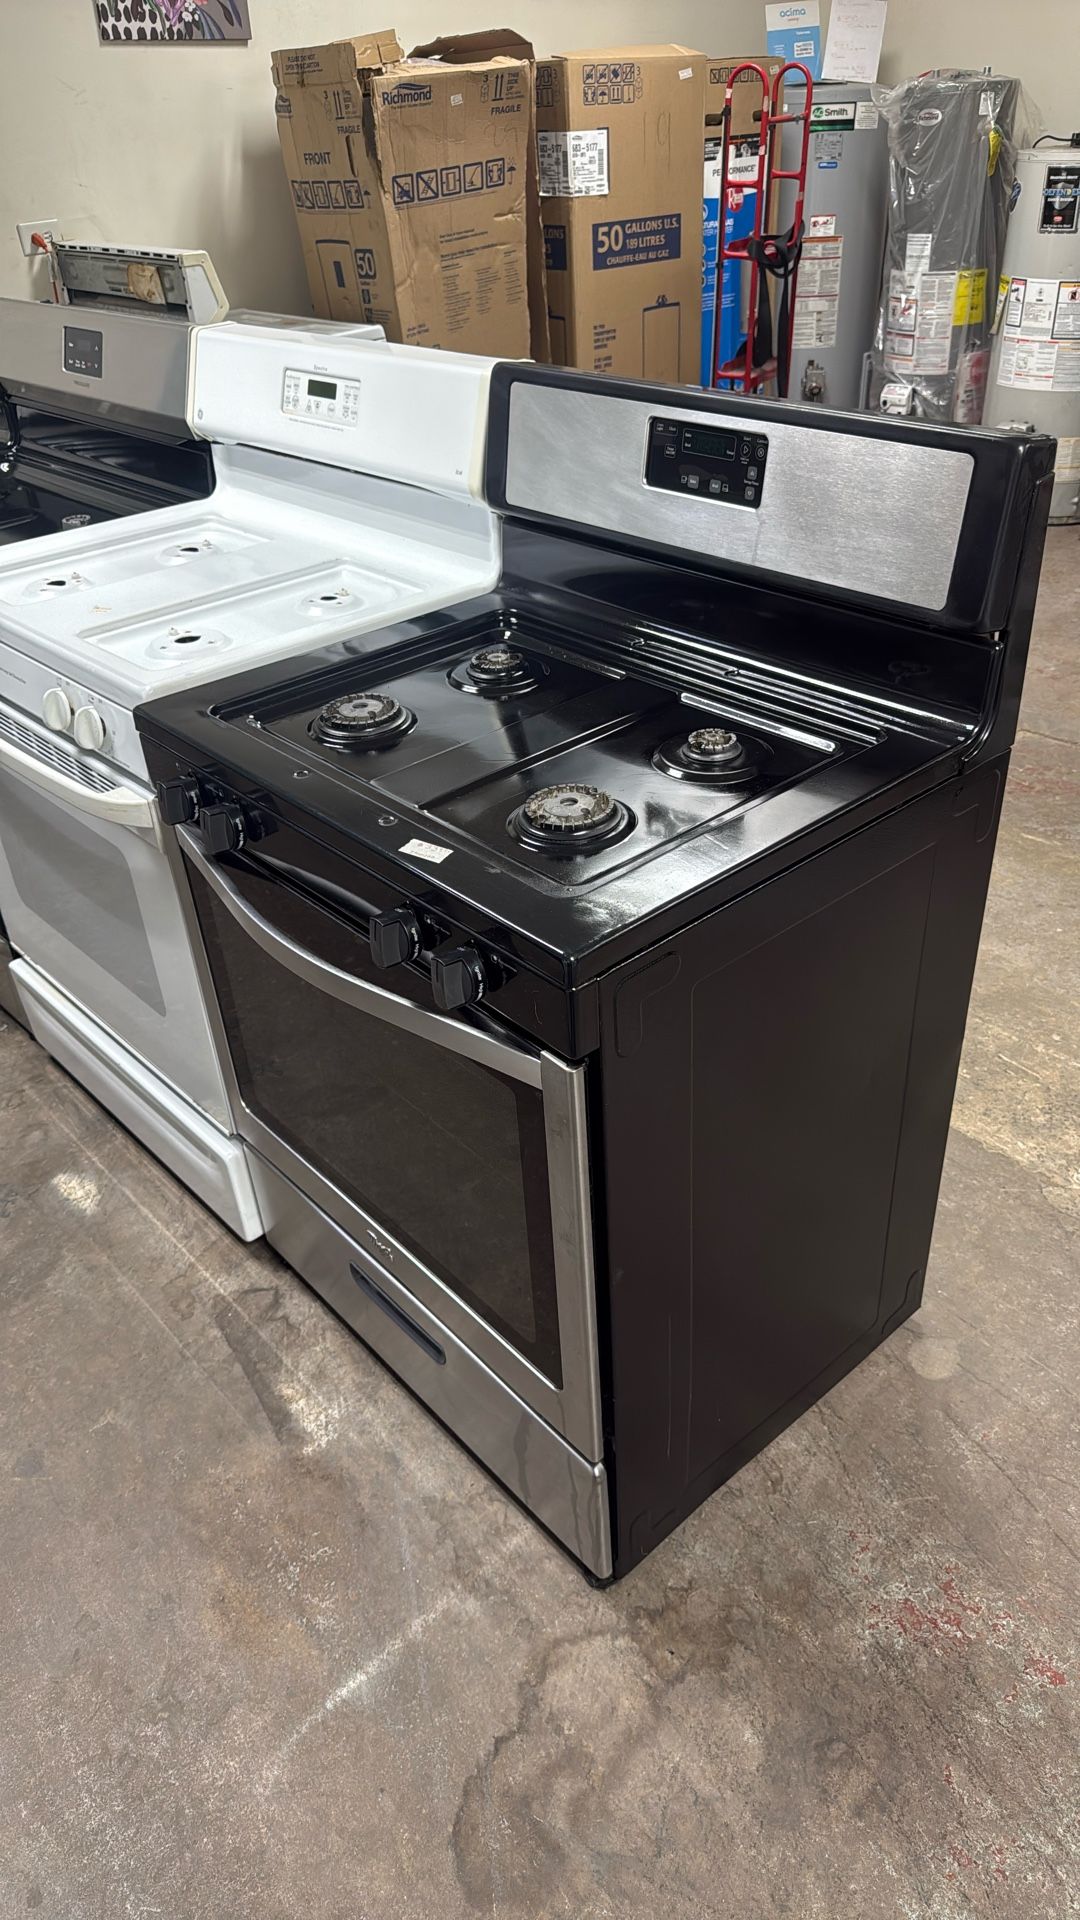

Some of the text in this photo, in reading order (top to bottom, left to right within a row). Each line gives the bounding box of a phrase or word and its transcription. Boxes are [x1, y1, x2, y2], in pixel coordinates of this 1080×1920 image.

[780, 8, 806, 17] acima
[382, 85, 432, 105] Richmond
[491, 104, 522, 115] FRAGILE
[825, 108, 848, 117] Smith
[304, 152, 331, 165] FRONT
[625, 217, 679, 234] GALLONS U.S.
[597, 225, 623, 253] 50
[626, 234, 666, 249] 189 LITRES
[357, 252, 375, 276] 50
[607, 253, 648, 266] CHAUFFE-EAU
